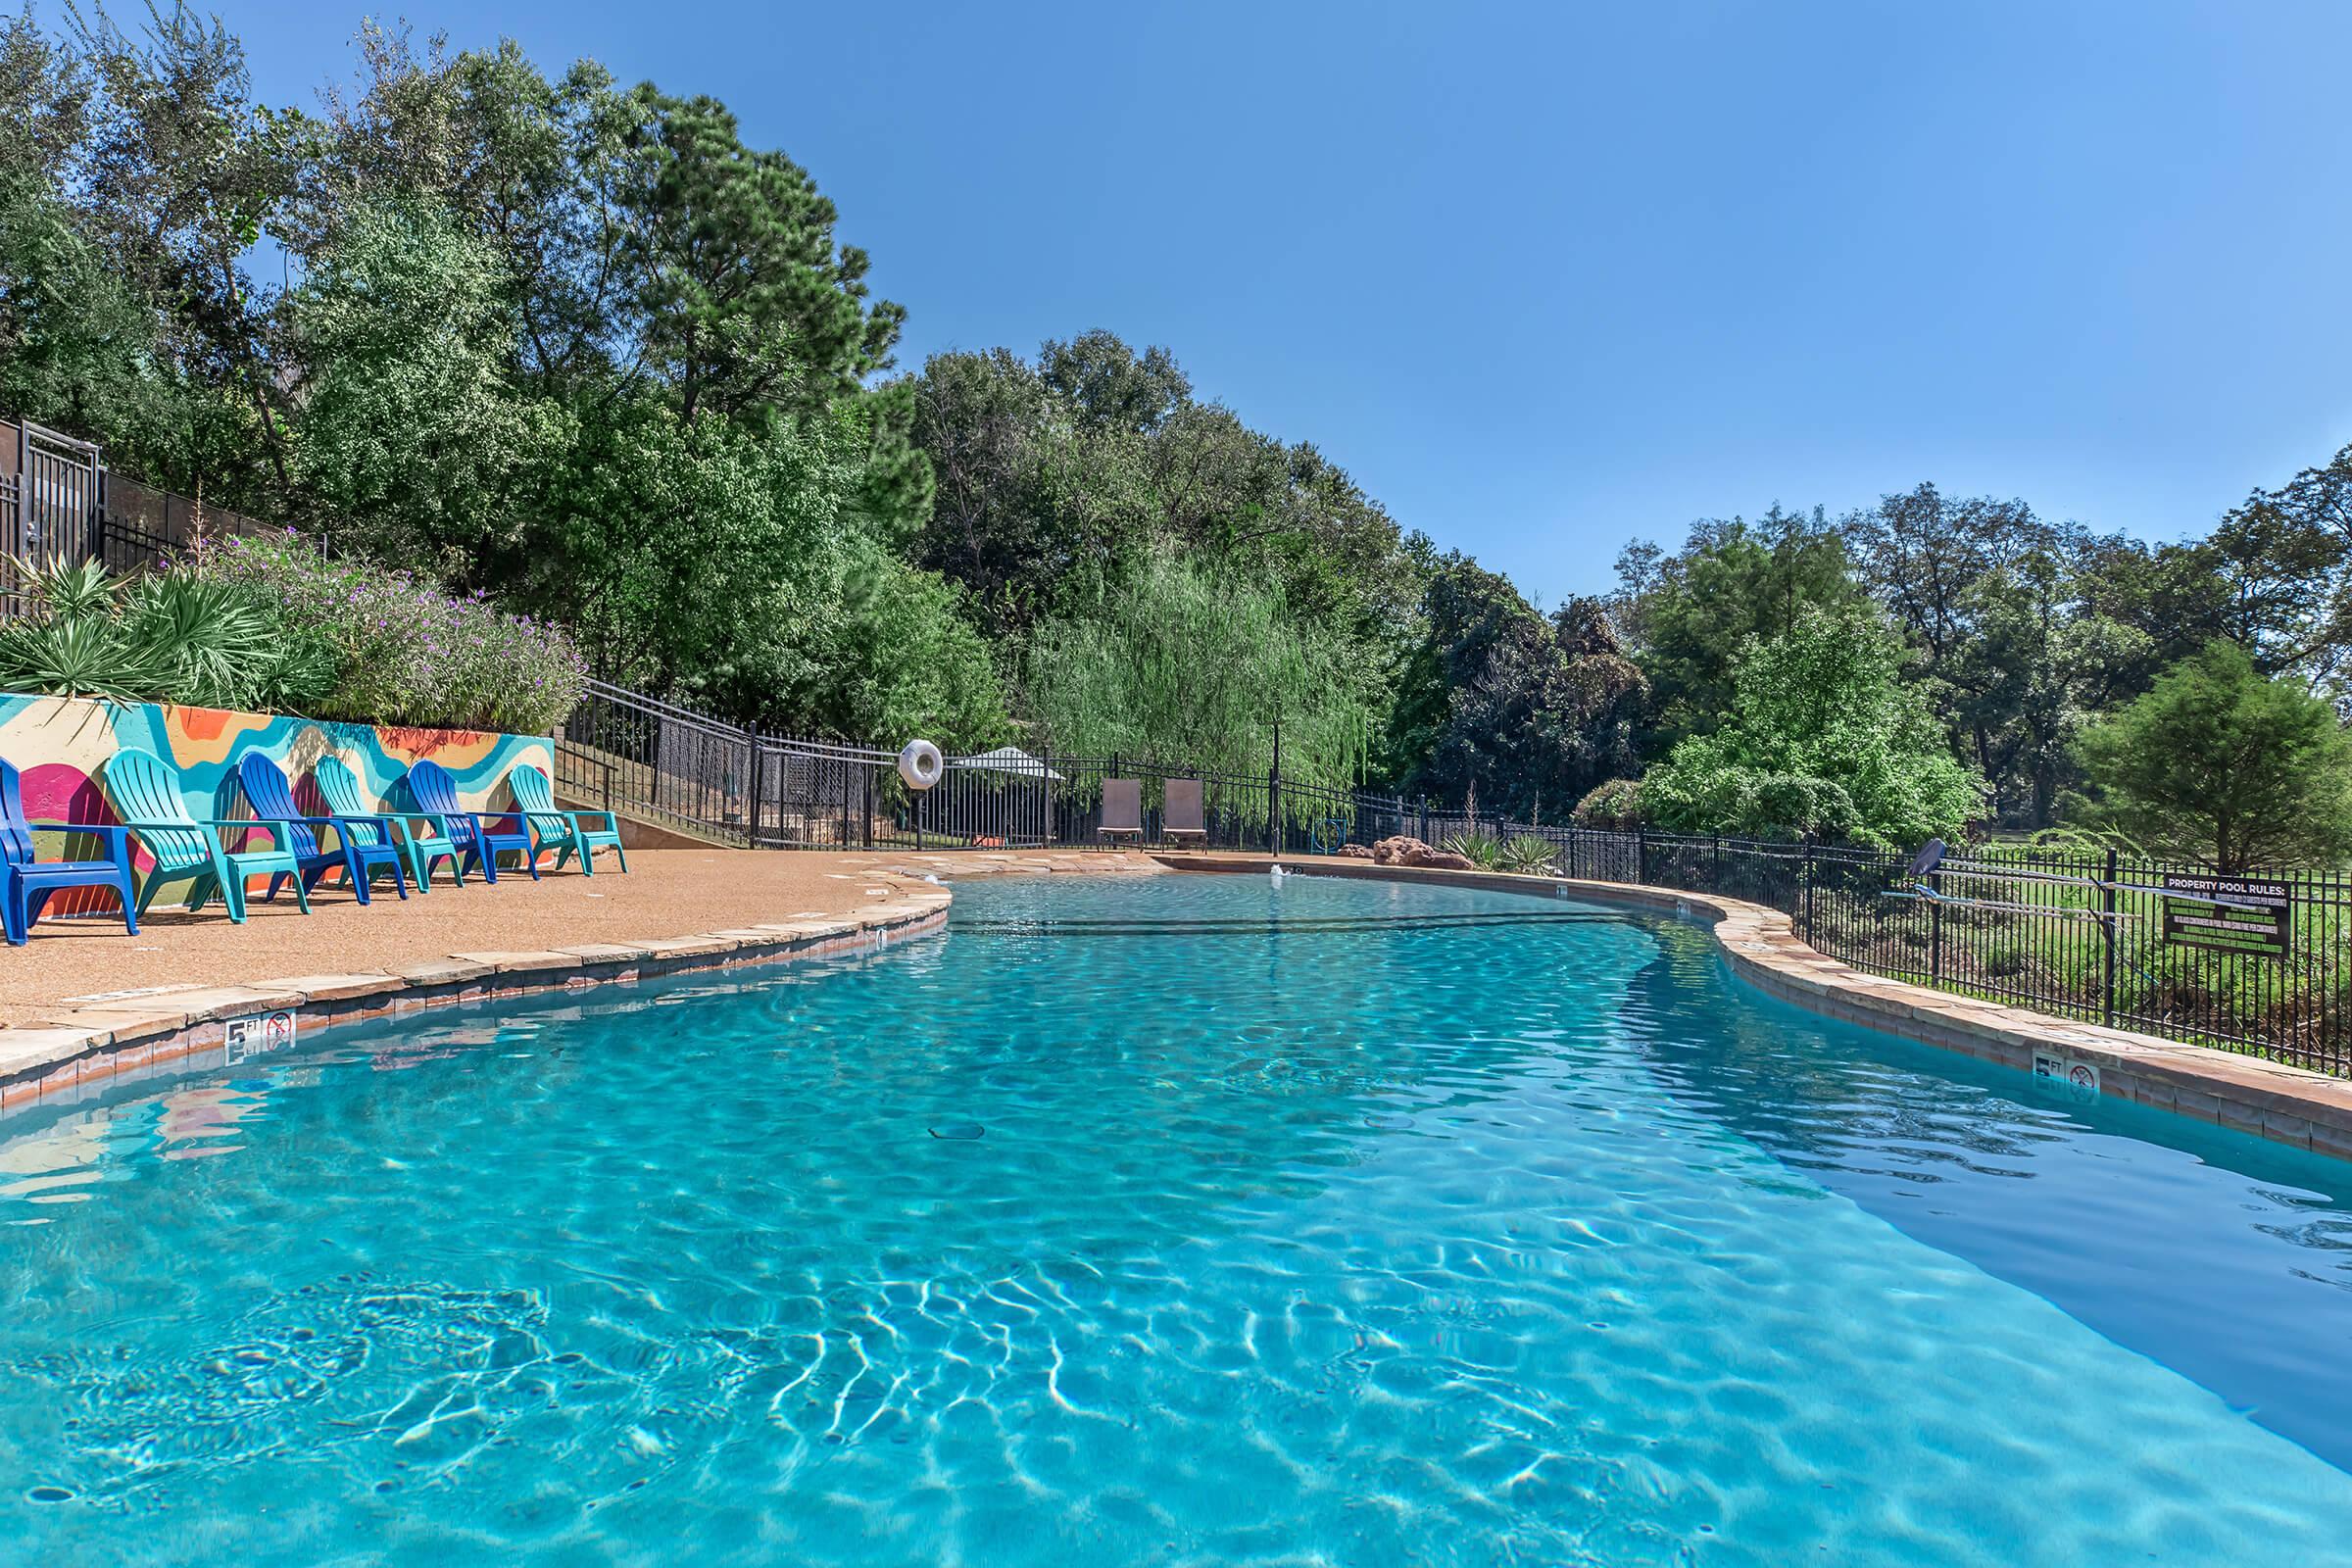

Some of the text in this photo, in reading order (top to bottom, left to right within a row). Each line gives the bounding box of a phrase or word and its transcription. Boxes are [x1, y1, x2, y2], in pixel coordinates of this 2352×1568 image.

[2169, 878, 2285, 896] PROPERTY POOL RULES:
[229, 1020, 258, 1043] 5 FT
